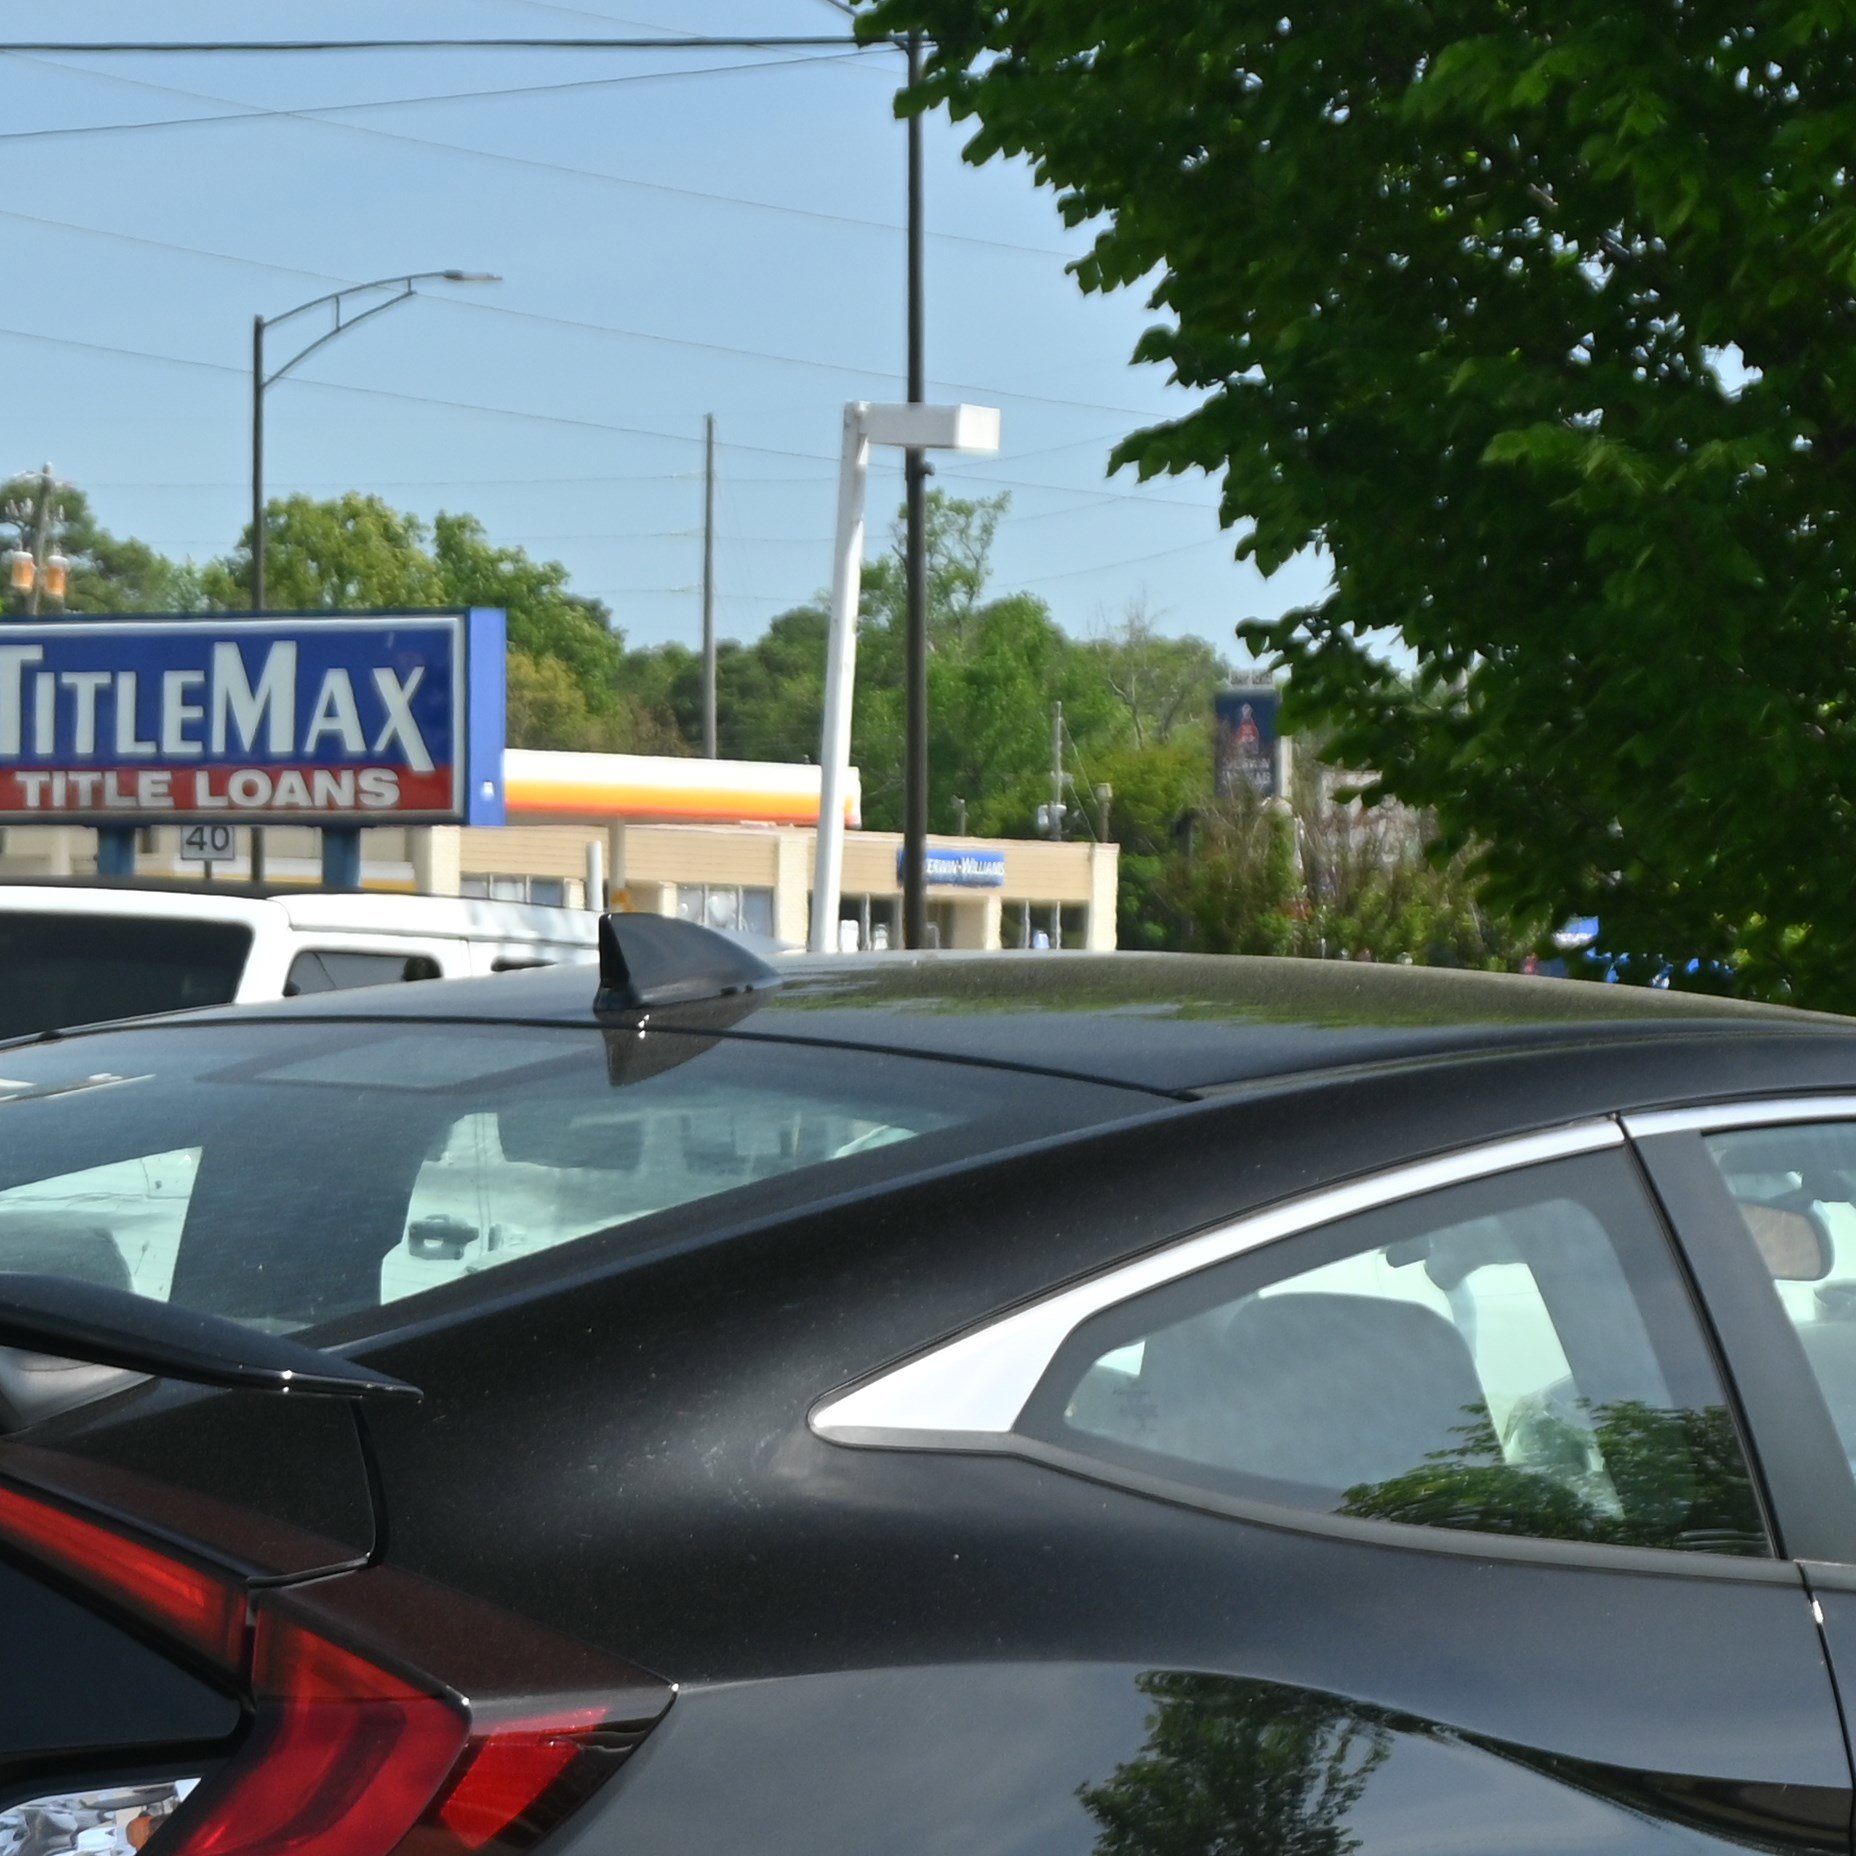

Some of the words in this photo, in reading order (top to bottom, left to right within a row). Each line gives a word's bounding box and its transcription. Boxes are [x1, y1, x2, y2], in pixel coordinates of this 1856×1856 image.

[14, 770, 175, 808] TITLE
[195, 768, 401, 808] LOANS
[185, 825, 230, 851] 40
